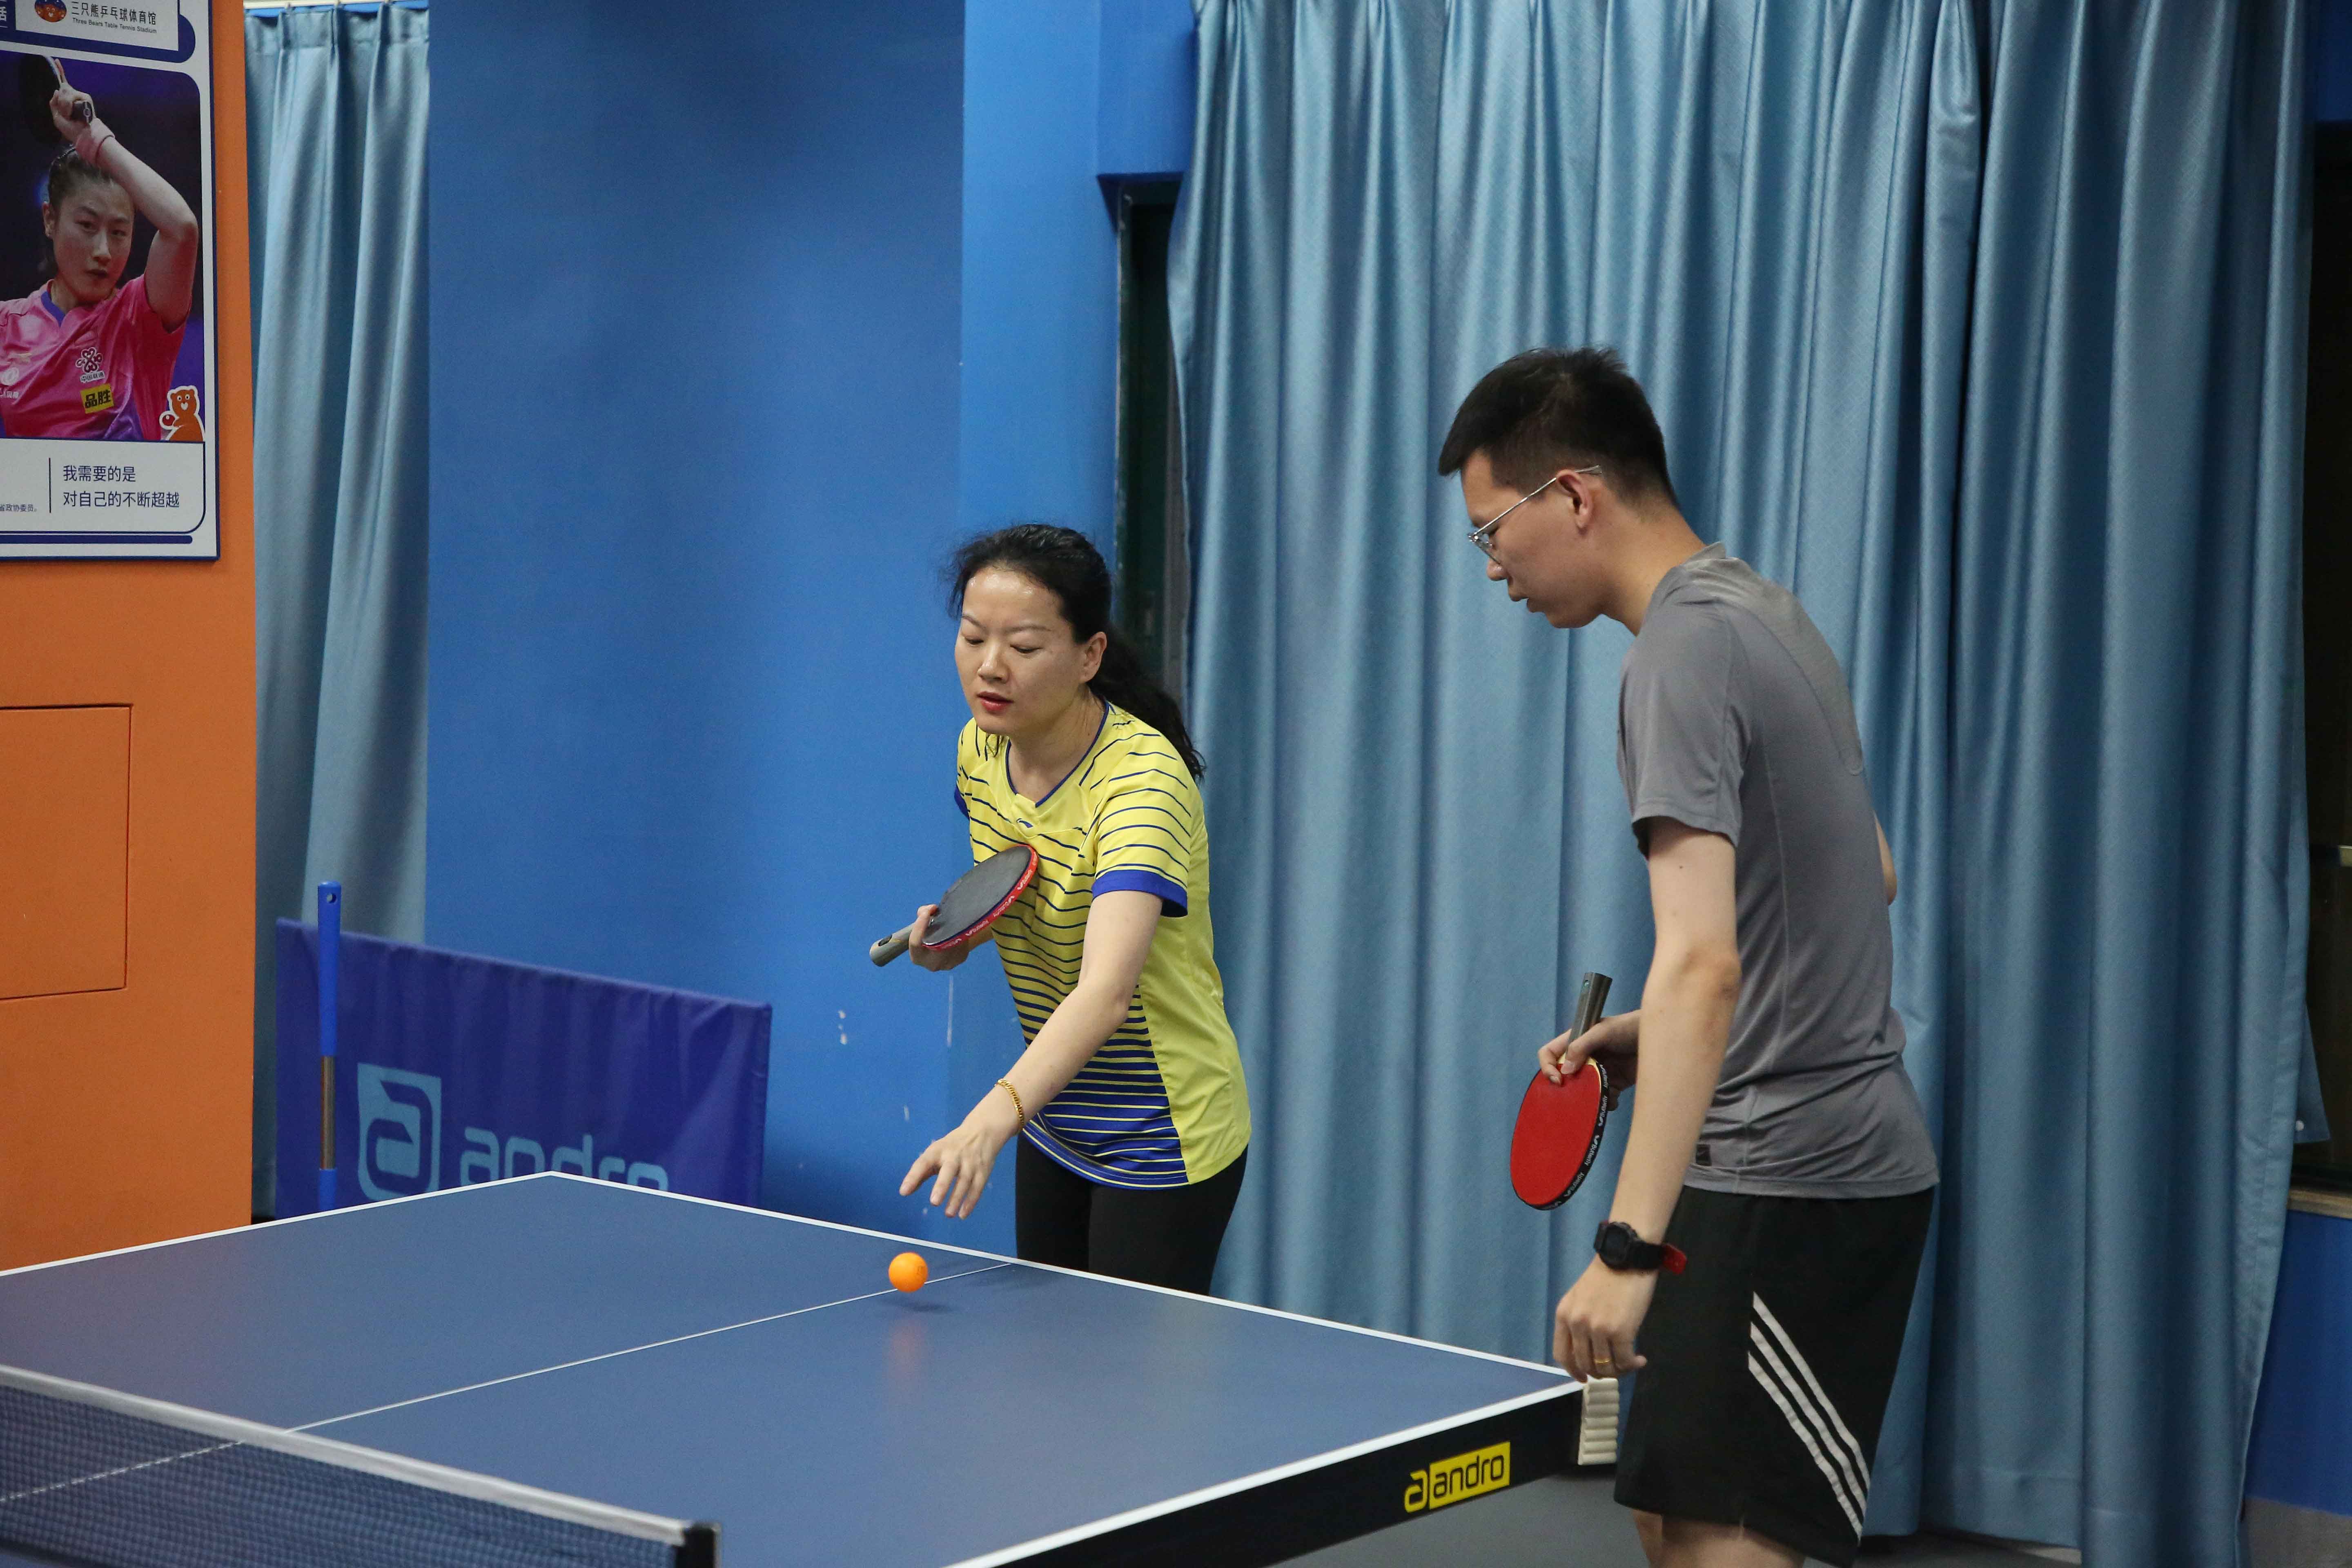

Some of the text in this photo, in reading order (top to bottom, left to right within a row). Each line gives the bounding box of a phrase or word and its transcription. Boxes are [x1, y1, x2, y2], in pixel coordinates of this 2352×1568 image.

[71, 1, 156, 25] 三只熊乒乓球体育馆
[85, 389, 110, 408] 品胜
[63, 465, 136, 482] 我需要的是
[63, 490, 179, 508] 对自己的不断超越
[1433, 1455, 1504, 1499] andro
